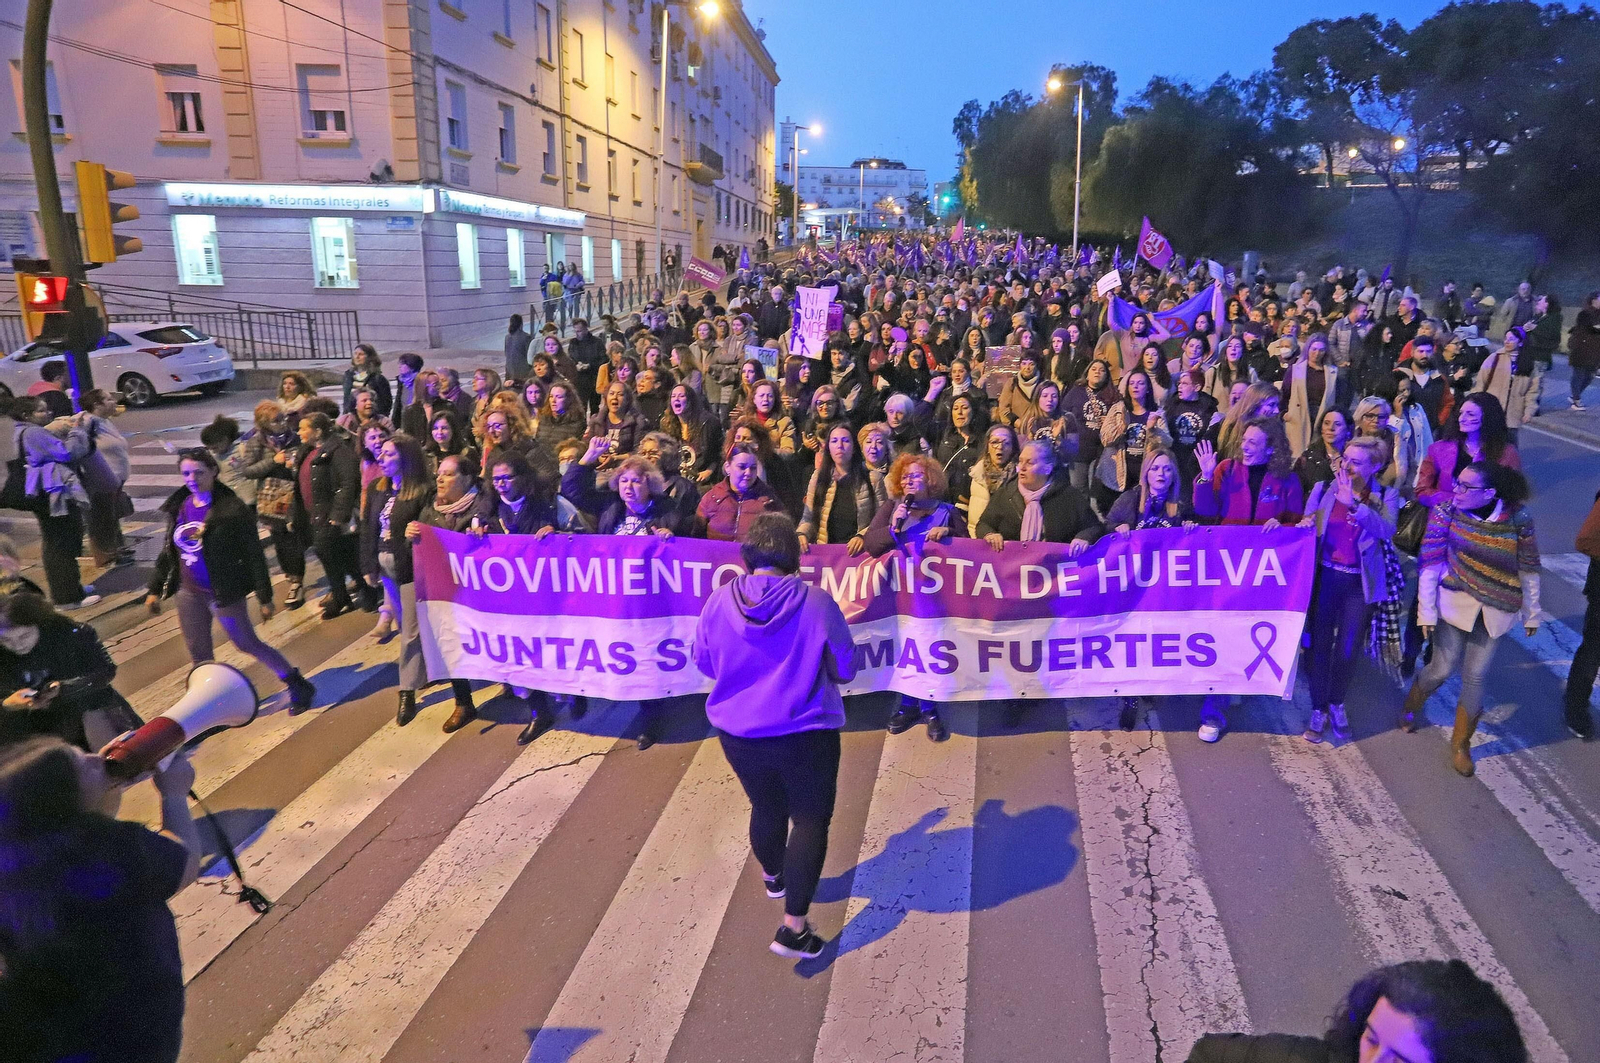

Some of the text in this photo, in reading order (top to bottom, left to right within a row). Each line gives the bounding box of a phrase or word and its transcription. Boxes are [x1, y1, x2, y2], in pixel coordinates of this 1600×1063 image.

[269, 194, 326, 206] Reformas
[329, 196, 390, 209] Integrales
[805, 292, 819, 306] NI
[804, 307, 826, 321] UNA
[448, 548, 1287, 604] MOVIMIENTO MINISTA DE HUELVA
[462, 627, 637, 675] JUNTAS
[978, 632, 1218, 673] FUERTES
